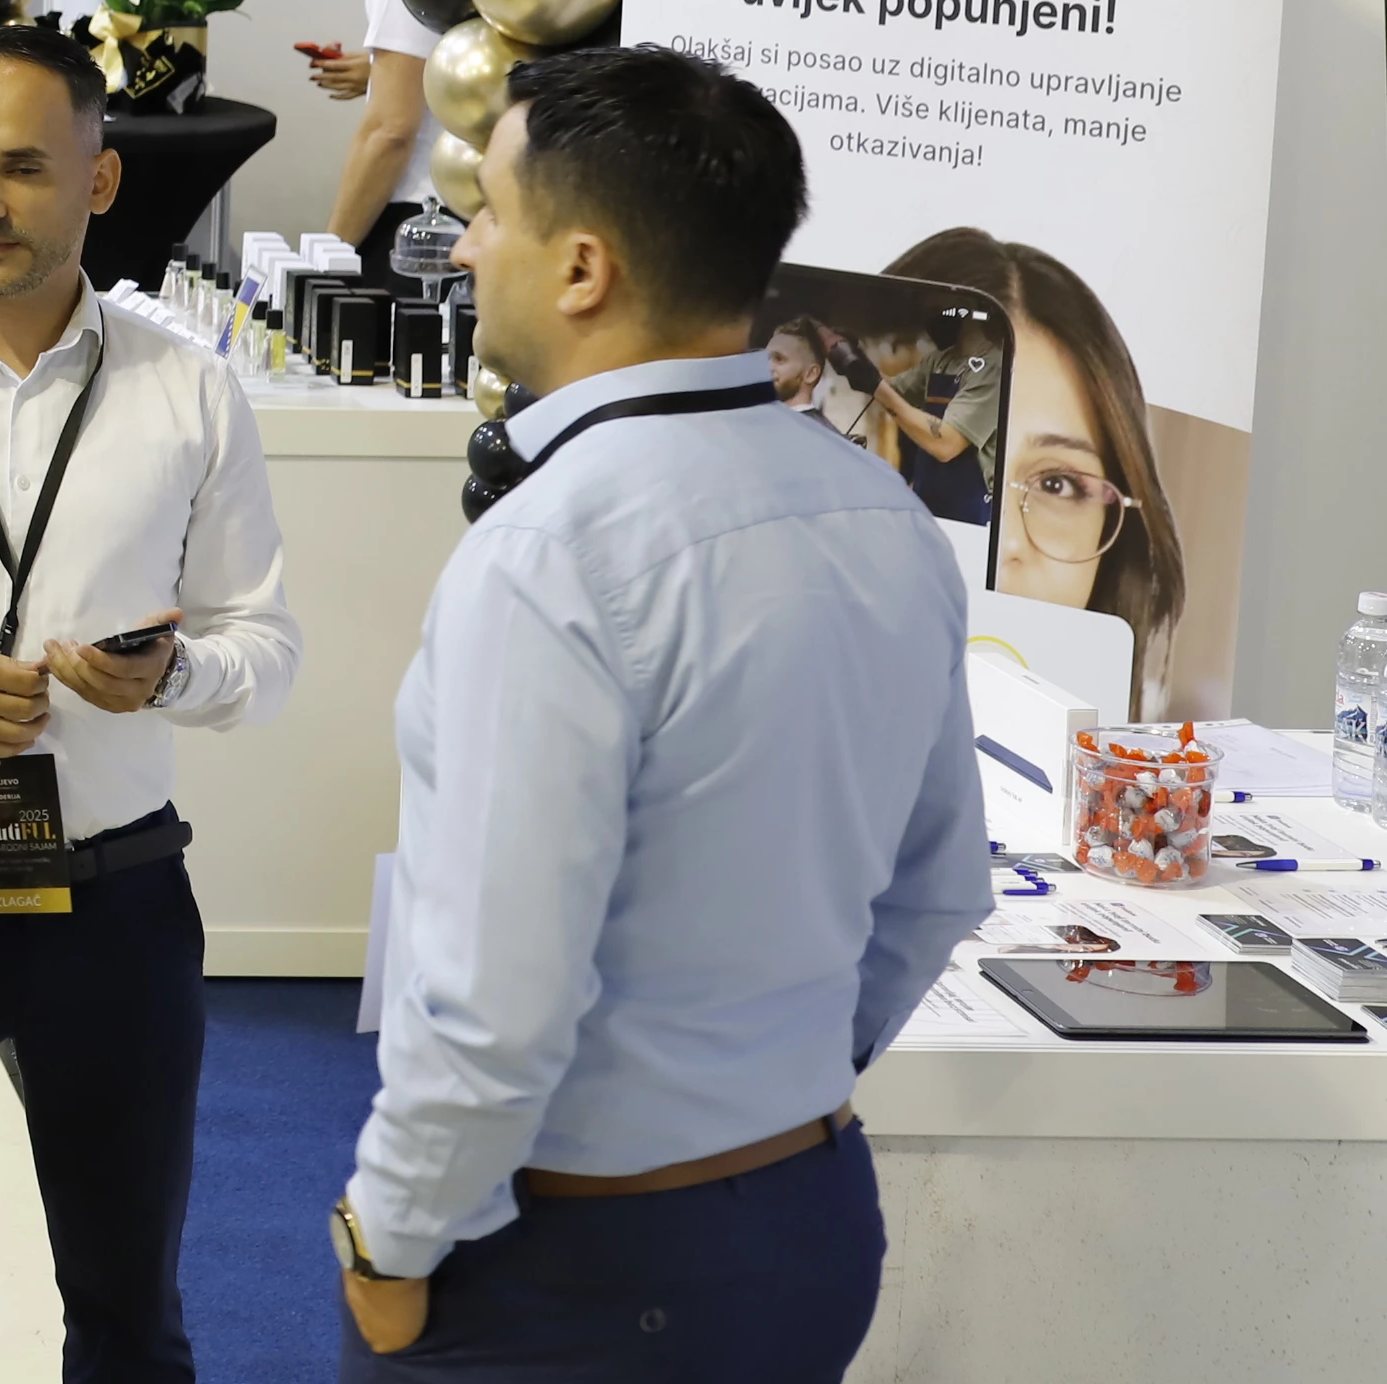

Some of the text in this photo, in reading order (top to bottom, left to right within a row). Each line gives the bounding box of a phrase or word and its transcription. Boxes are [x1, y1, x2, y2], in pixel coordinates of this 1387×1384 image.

[670, 33, 1184, 106] Olakšaj si posao uz digitalno upravljanje
[876, 91, 931, 121] Više
[938, 99, 1055, 139] klijenata,
[1063, 116, 1149, 145] manje
[829, 130, 985, 169] otkazivanja!
[19, 810, 50, 822] 2025
